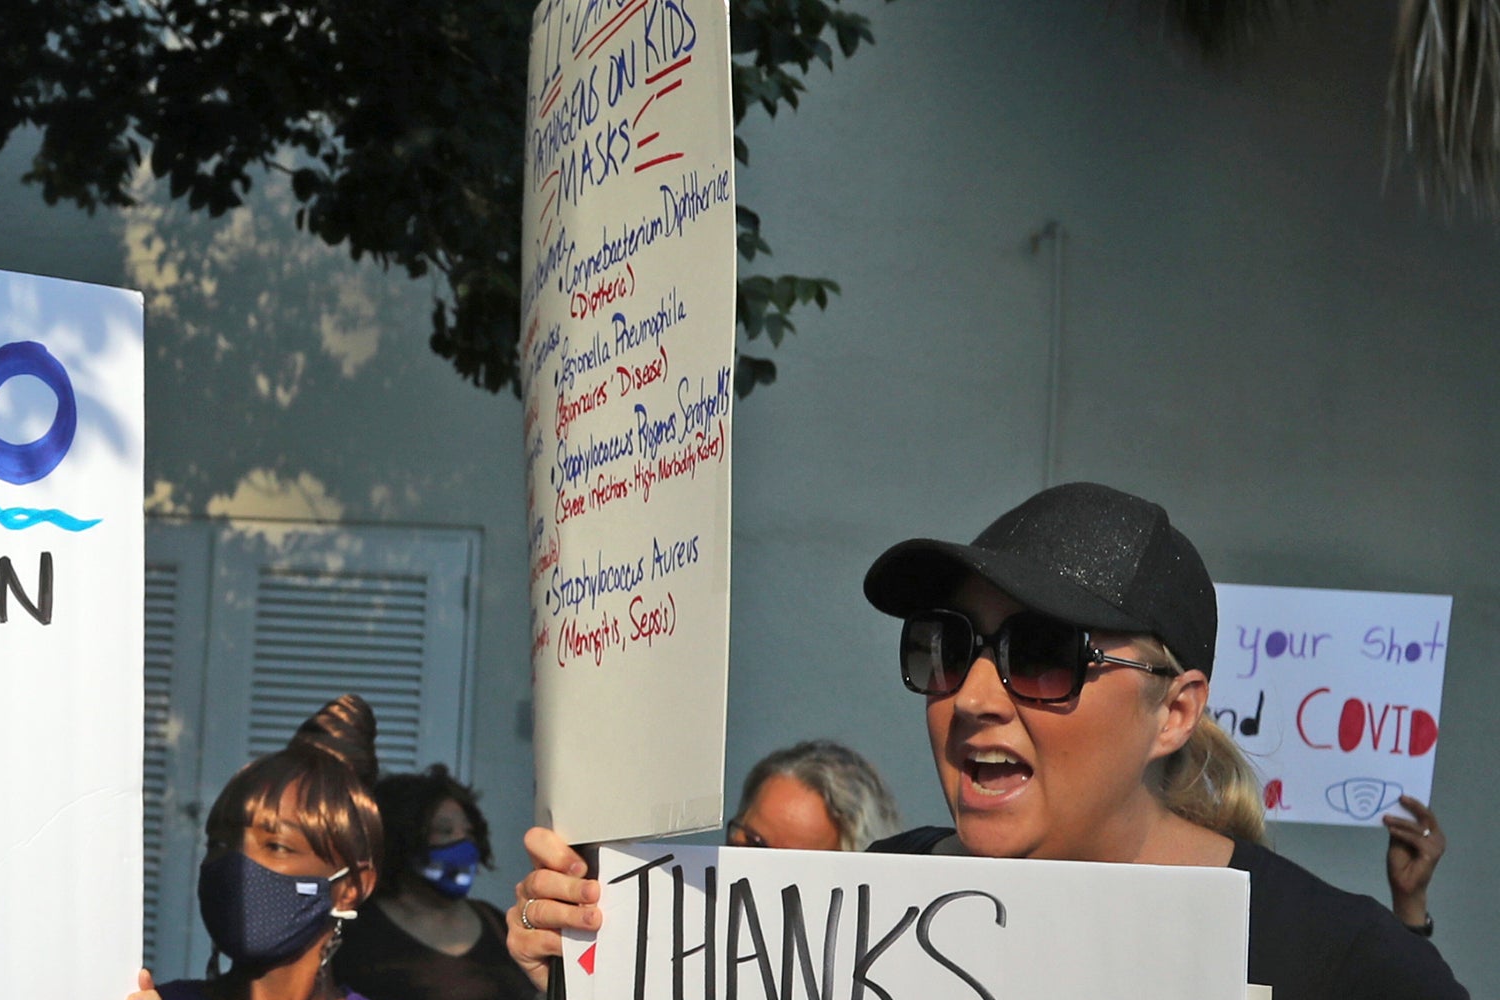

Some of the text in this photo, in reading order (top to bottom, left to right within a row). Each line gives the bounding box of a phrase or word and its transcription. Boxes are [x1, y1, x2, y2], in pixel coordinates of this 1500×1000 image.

[608, 40, 636, 107] ON
[557, 118, 631, 216] MASKS
[634, 460, 657, 503] High
[1236, 624, 1332, 679] your
[1206, 687, 1438, 757] nd COVID
